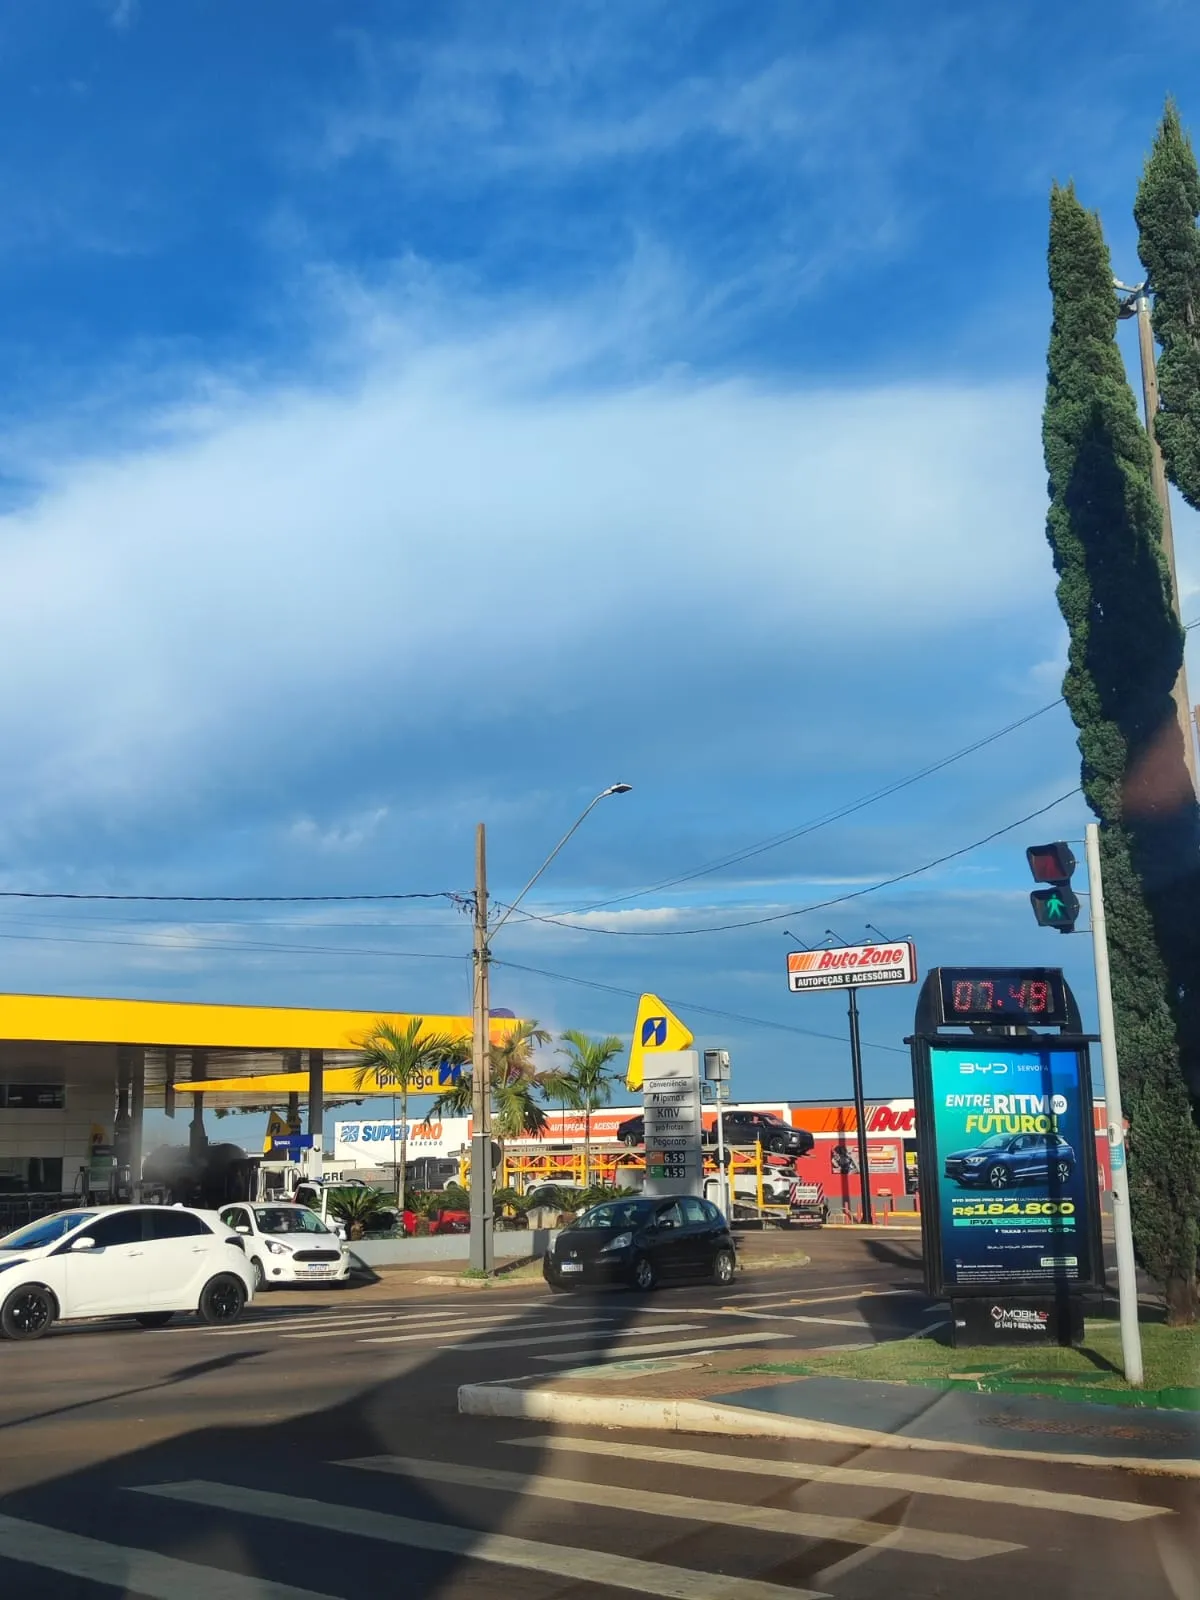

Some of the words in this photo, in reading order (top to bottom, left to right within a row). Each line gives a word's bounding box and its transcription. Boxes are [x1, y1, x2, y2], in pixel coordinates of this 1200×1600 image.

[818, 947, 904, 969] AutoZone
[797, 975, 843, 987] AUTOPEÇAS
[845, 974, 850, 982] E
[852, 969, 903, 982] ACESSÓRIOS
[959, 1063, 1008, 1074] BYD
[375, 1071, 433, 1090] Ipirnga
[649, 1080, 688, 1088] Conveniência
[945, 1094, 991, 1107] ENTRE
[657, 1108, 680, 1118] KMV
[361, 1125, 411, 1141] SUPER
[410, 1122, 443, 1140] PRO
[965, 1114, 1058, 1134] FUTURO!
